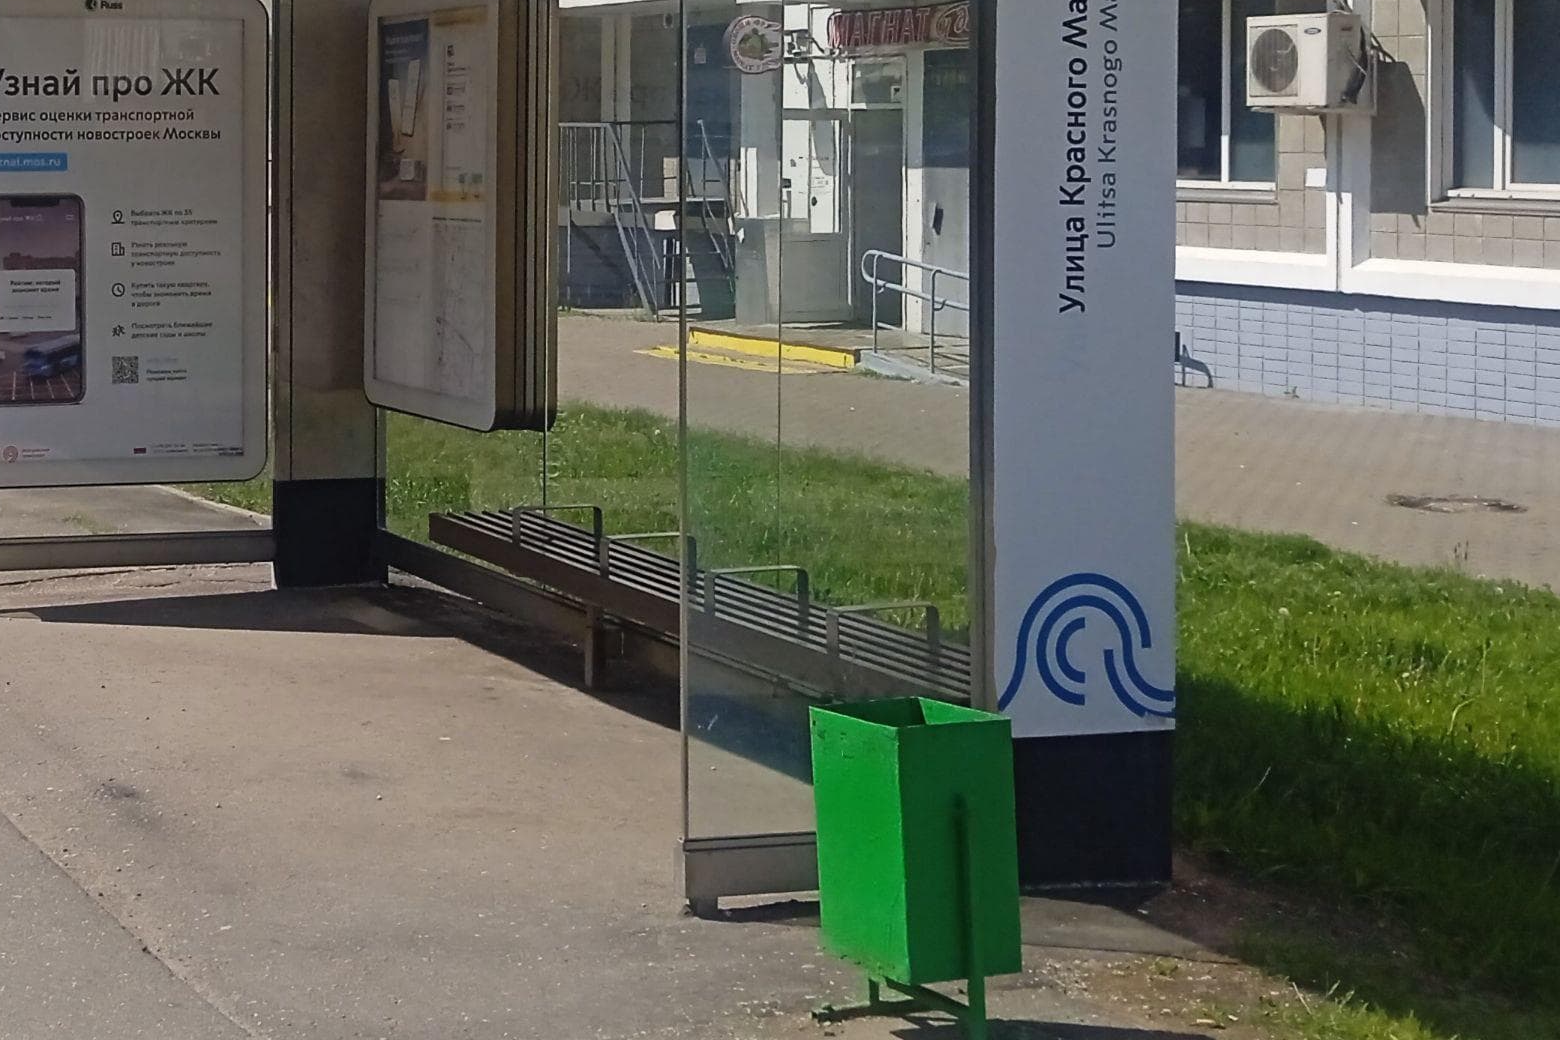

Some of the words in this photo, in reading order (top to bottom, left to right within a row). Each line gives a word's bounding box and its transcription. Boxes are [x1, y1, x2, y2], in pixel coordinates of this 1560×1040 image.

[100, 0, 123, 10] Russ
[92, 75, 152, 102] про
[160, 67, 220, 96] ЖК
[1097, 39, 1123, 163] Krasnogo
[39, 111, 92, 123] оценки
[95, 109, 194, 123] транспортной
[77, 130, 160, 143] новостроек
[162, 127, 221, 140] Москвы
[1059, 58, 1092, 206] Красного
[1097, 173, 1116, 248] Ulitsa
[1059, 216, 1086, 313] Улица
